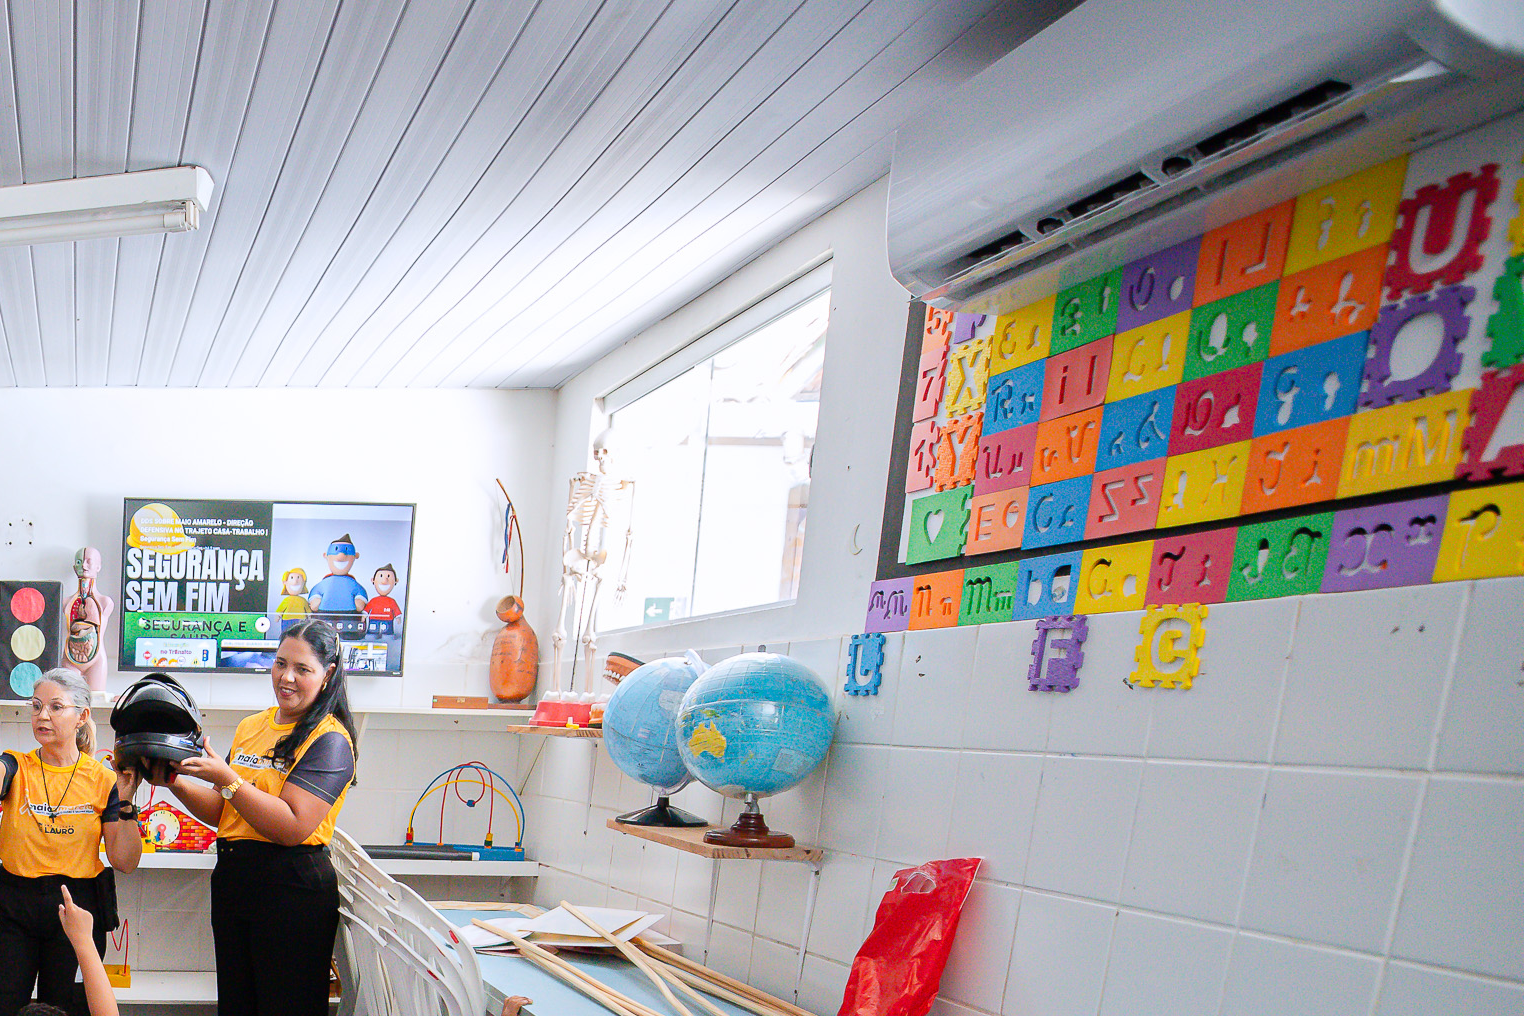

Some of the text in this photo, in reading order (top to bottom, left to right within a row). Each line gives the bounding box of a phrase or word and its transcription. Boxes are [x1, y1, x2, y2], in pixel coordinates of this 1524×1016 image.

[1409, 189, 1476, 275] U
[213, 528, 264, 536] CASA-TRABALHO
[227, 518, 253, 527] DIREÇÃO
[126, 547, 265, 591] SEGURANÇA
[125, 580, 230, 612] SEM FIM
[143, 617, 247, 635] SEGURANÇA E
